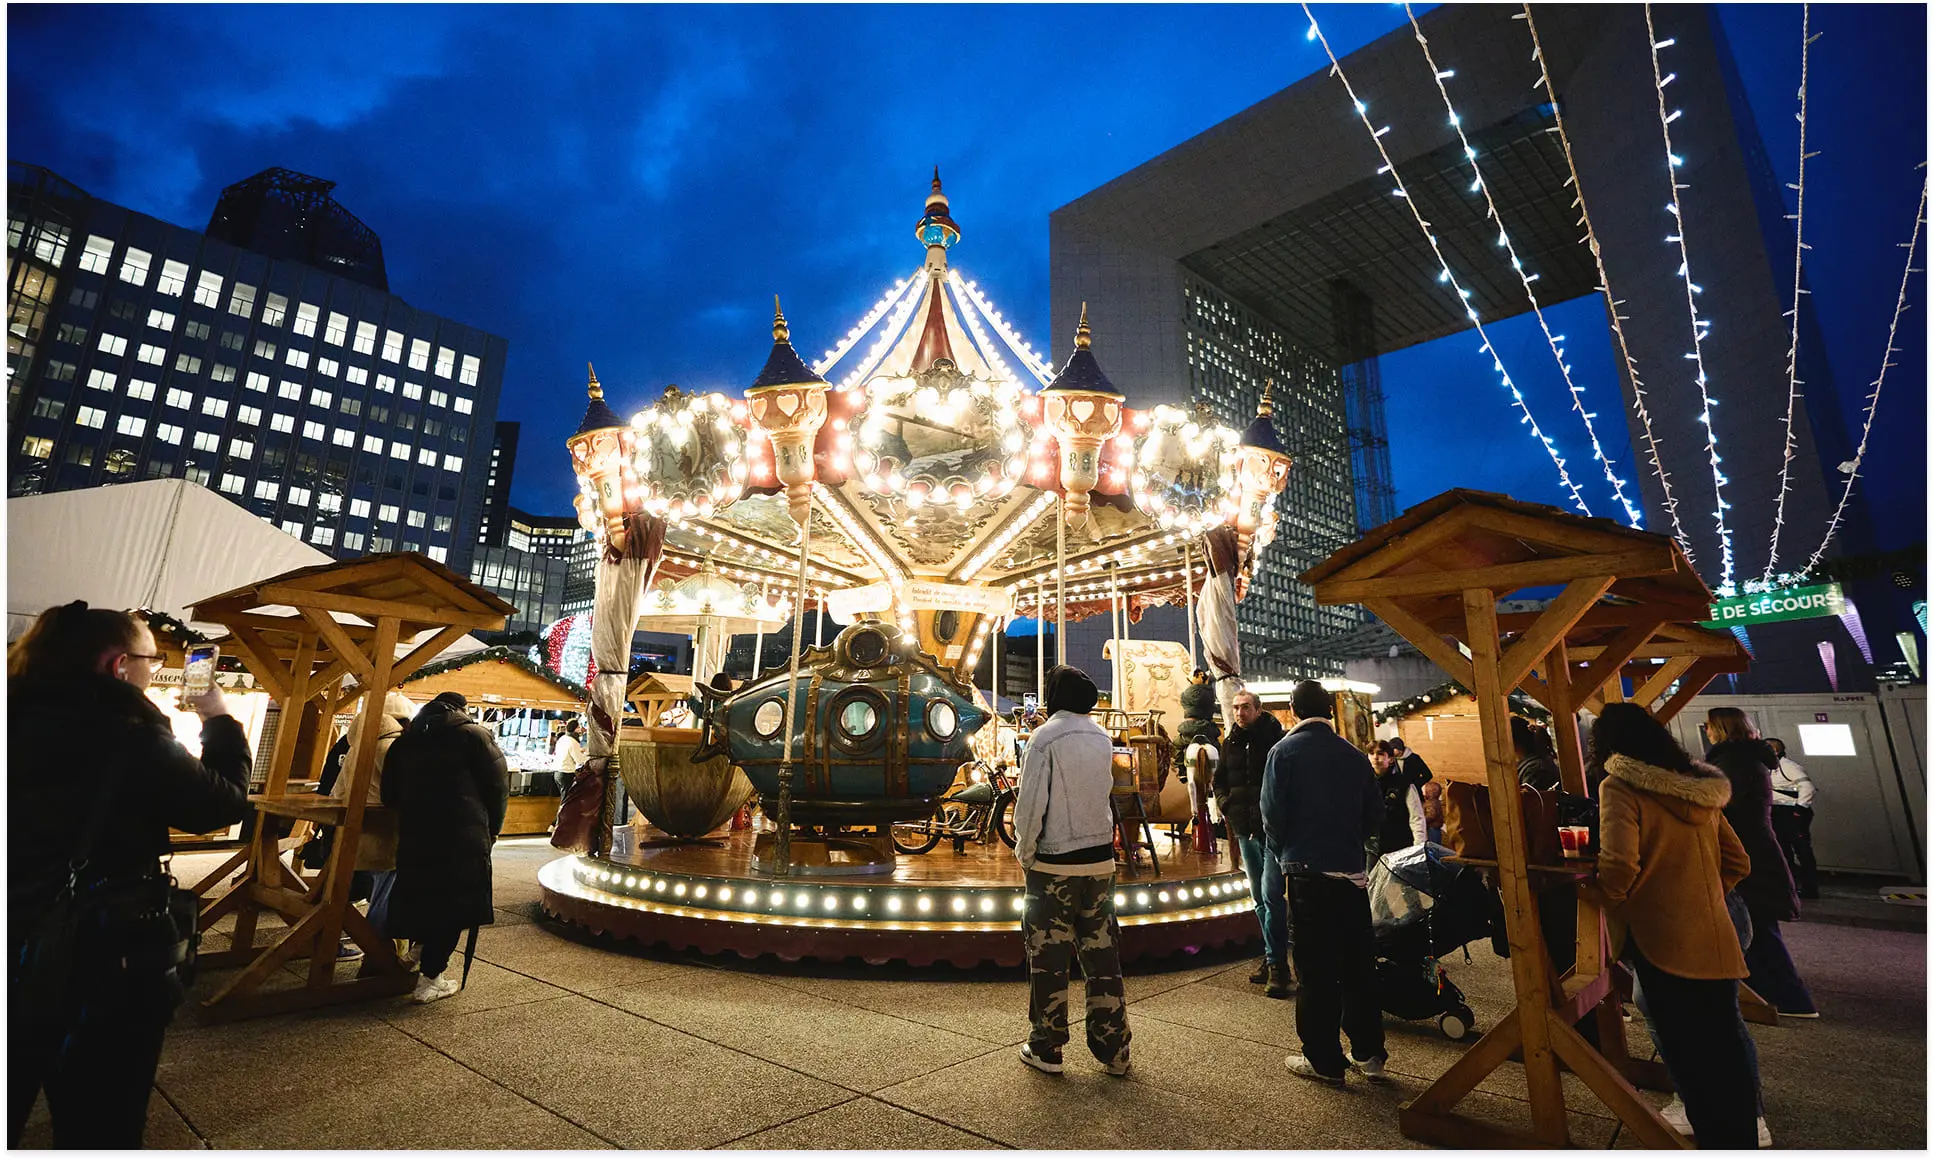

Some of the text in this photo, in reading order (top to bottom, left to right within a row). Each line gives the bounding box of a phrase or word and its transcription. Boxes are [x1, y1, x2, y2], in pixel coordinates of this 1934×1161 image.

[1711, 593, 1838, 621] E DE SECOURS
